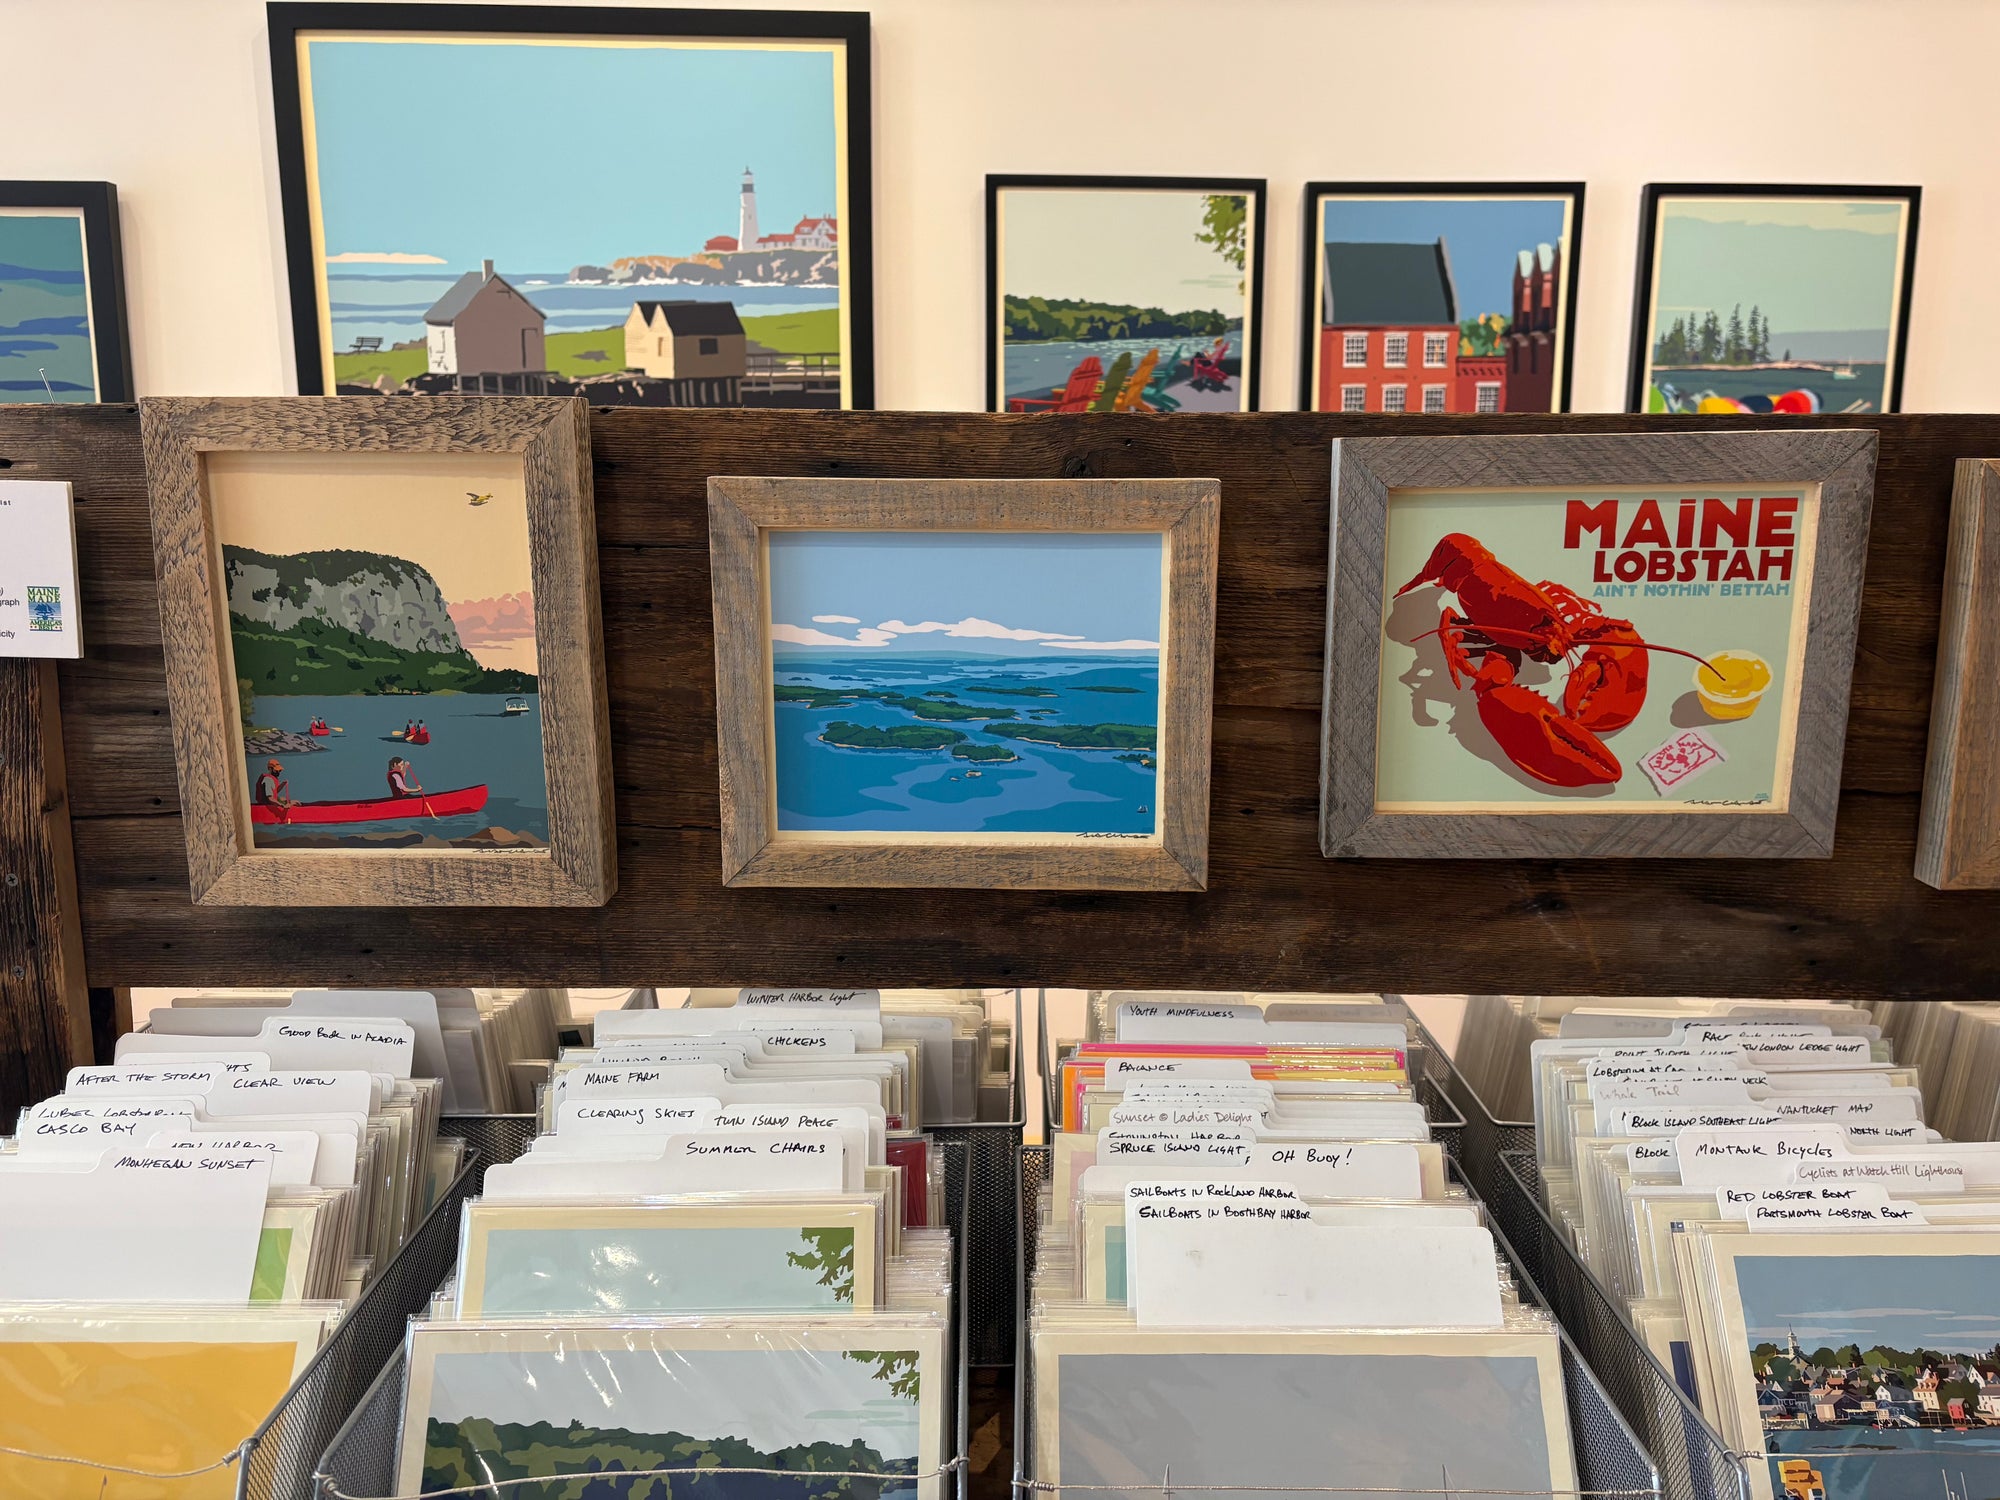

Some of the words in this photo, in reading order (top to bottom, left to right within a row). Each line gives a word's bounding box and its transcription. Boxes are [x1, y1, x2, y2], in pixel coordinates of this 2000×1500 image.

[1593, 549, 1794, 583] LOBSTAH
[27, 587, 60, 596] MAINE
[1593, 584, 1637, 598] AIN'T
[1643, 584, 1715, 597] NOTHIN'
[1720, 583, 1790, 597] BETTAH
[27, 594, 61, 603] MADE
[788, 992, 824, 1003] HARBOR
[1166, 1006, 1235, 1018] MINDFULNESS
[767, 1036, 827, 1047] CHICKENS
[1119, 1062, 1182, 1073] BALANCE
[75, 1073, 120, 1086] AFTER
[125, 1074, 157, 1082] THE
[161, 1072, 211, 1082] STORM
[232, 1078, 283, 1089] CLEAR
[293, 1077, 337, 1086] VIEW
[584, 1073, 622, 1086] MAINE
[627, 1072, 660, 1083] FARM
[1112, 1111, 1156, 1124] Sunset
[1173, 1110, 1210, 1124] Ladies
[1213, 1111, 1253, 1126] Delight
[37, 1123, 89, 1135] CASCO
[101, 1122, 137, 1136] BAY
[769, 1142, 826, 1154] CHAIRS
[1109, 1142, 1156, 1154] SPRUCE
[1271, 1149, 1296, 1162] OH
[200, 1158, 265, 1170] SUNSET
[1798, 1167, 1839, 1182] Cyclists
[1258, 1187, 1297, 1200] HARBOR
[1727, 1190, 1756, 1203] RED
[1762, 1191, 1816, 1200] LOBSTER
[1138, 1206, 1202, 1219] SAILBOATS
[1828, 1207, 1877, 1219] LOBSTER
